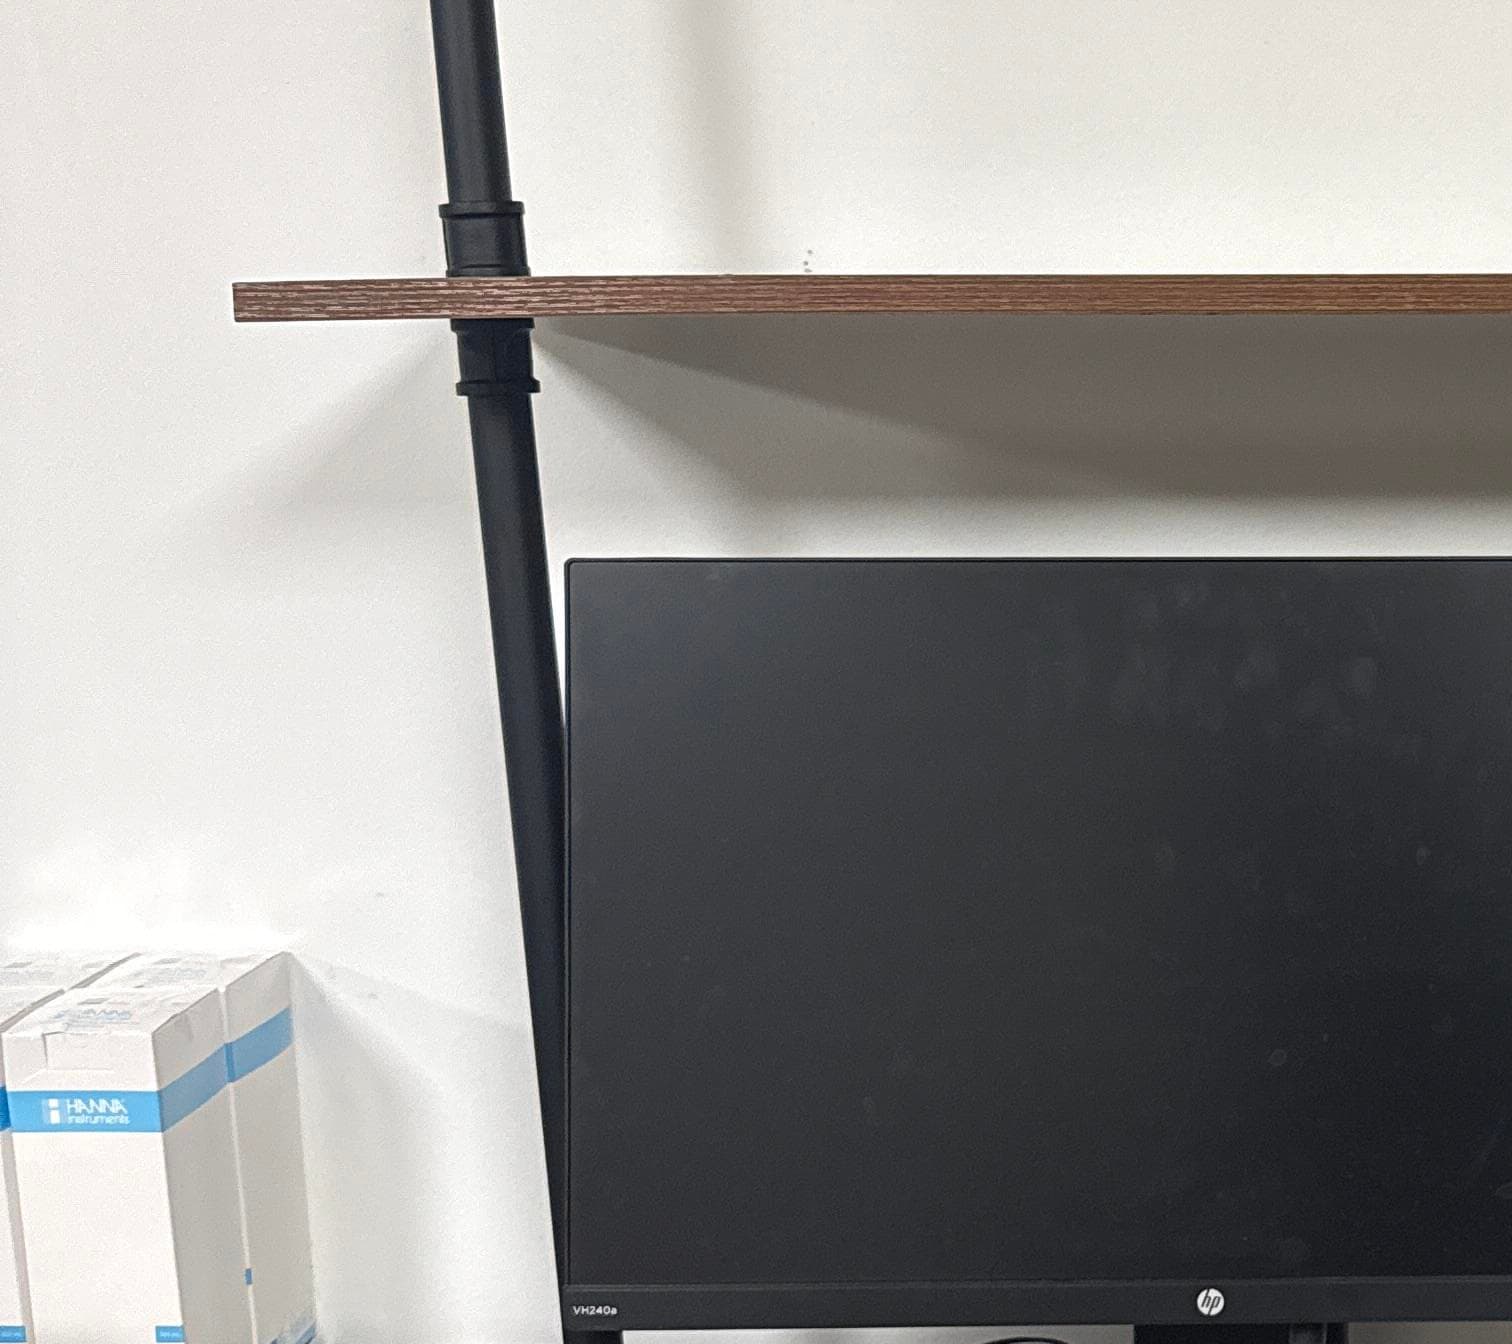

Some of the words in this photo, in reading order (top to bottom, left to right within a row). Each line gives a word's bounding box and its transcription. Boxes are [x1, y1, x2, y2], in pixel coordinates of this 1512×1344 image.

[66, 1098, 128, 1114] HANNA
[1199, 1288, 1223, 1316] hp
[572, 1305, 618, 1316] VH240a
